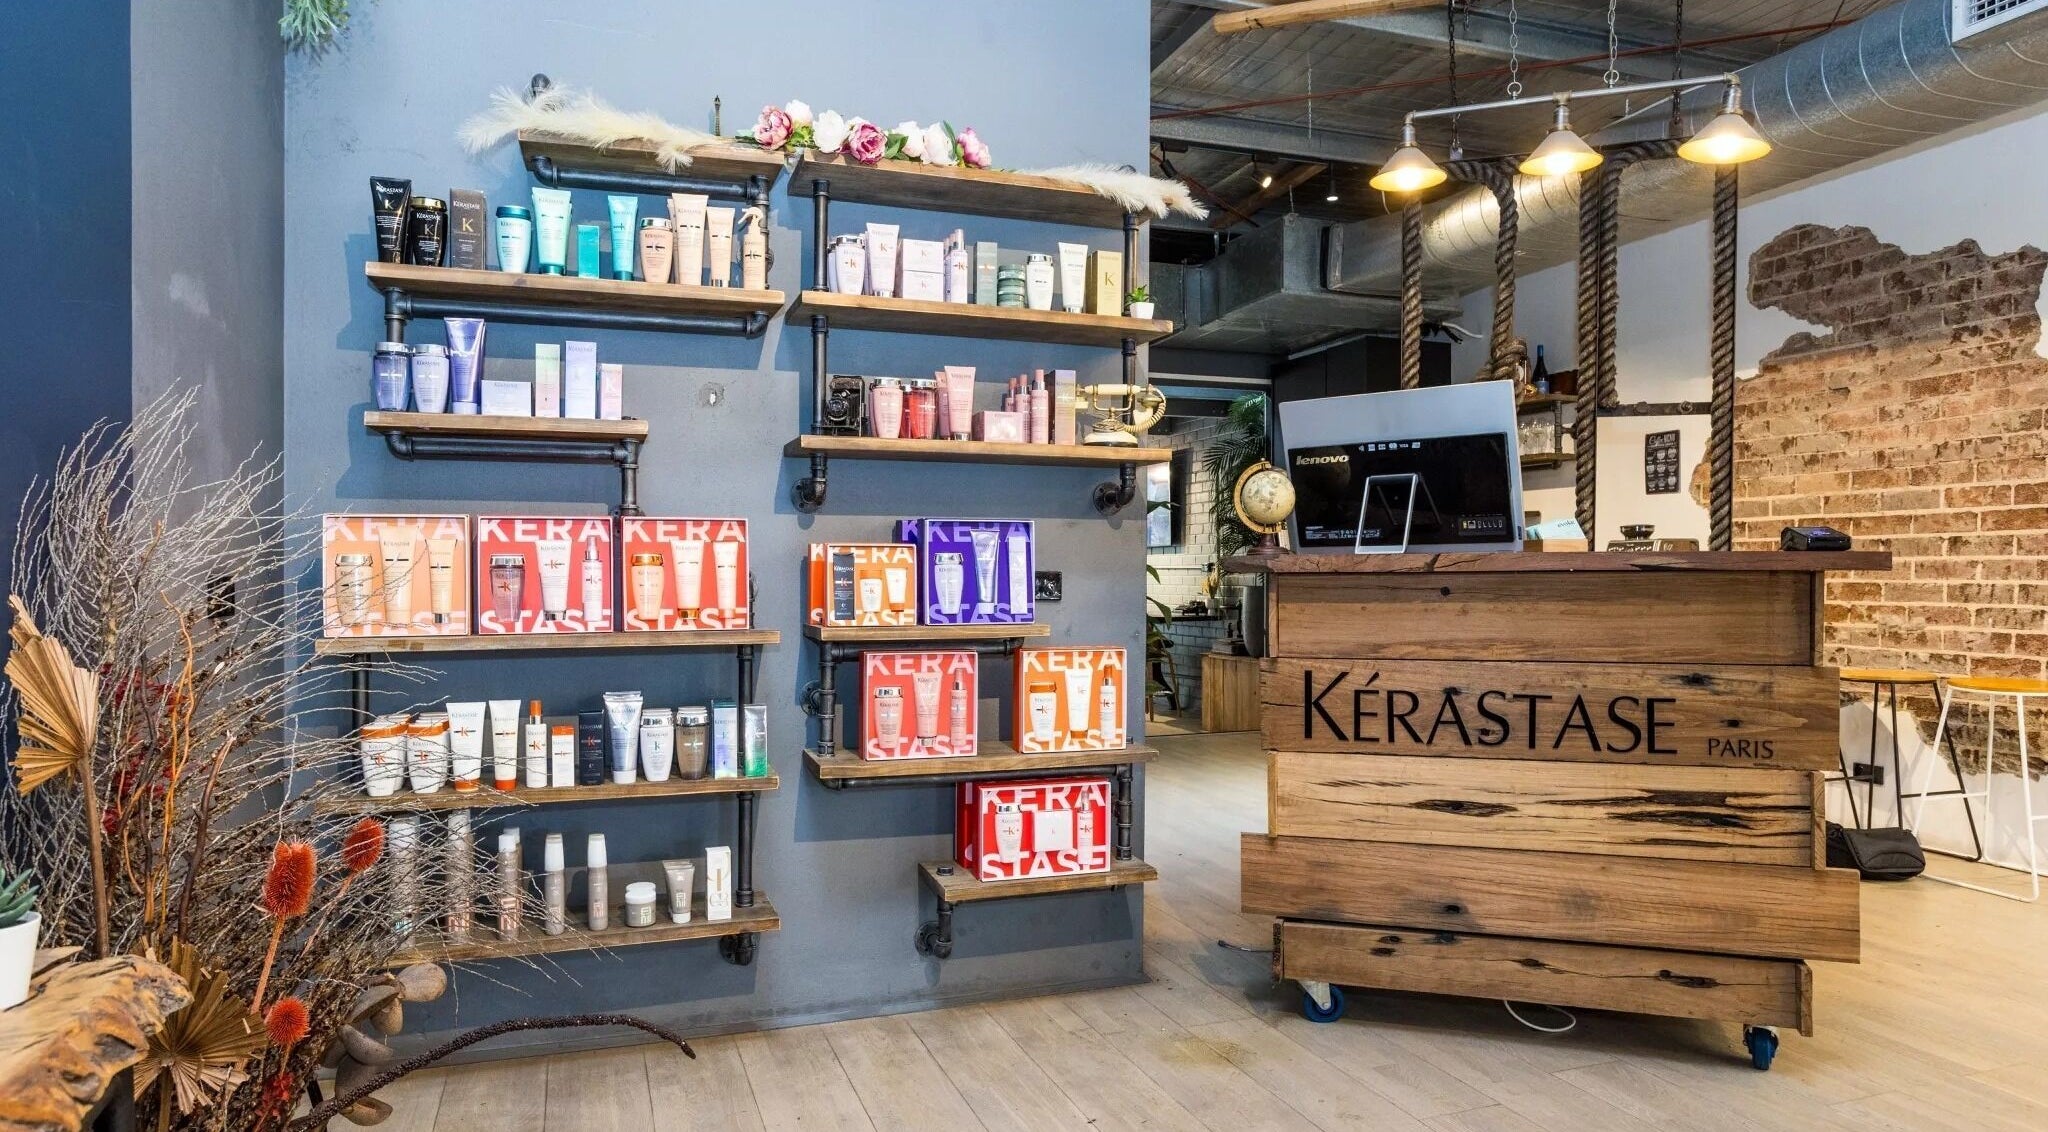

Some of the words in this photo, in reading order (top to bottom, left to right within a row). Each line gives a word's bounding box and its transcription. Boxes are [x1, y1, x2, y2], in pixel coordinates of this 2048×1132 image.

[1296, 455, 1350, 466] lenovo
[480, 519, 610, 543] KERA
[624, 520, 746, 543] KERA
[868, 654, 973, 677] KERA
[1022, 651, 1122, 673] KERA
[1304, 670, 1678, 755] KÉRASTASE
[1707, 738, 1774, 759] PARIS
[982, 783, 1105, 816] KERA
